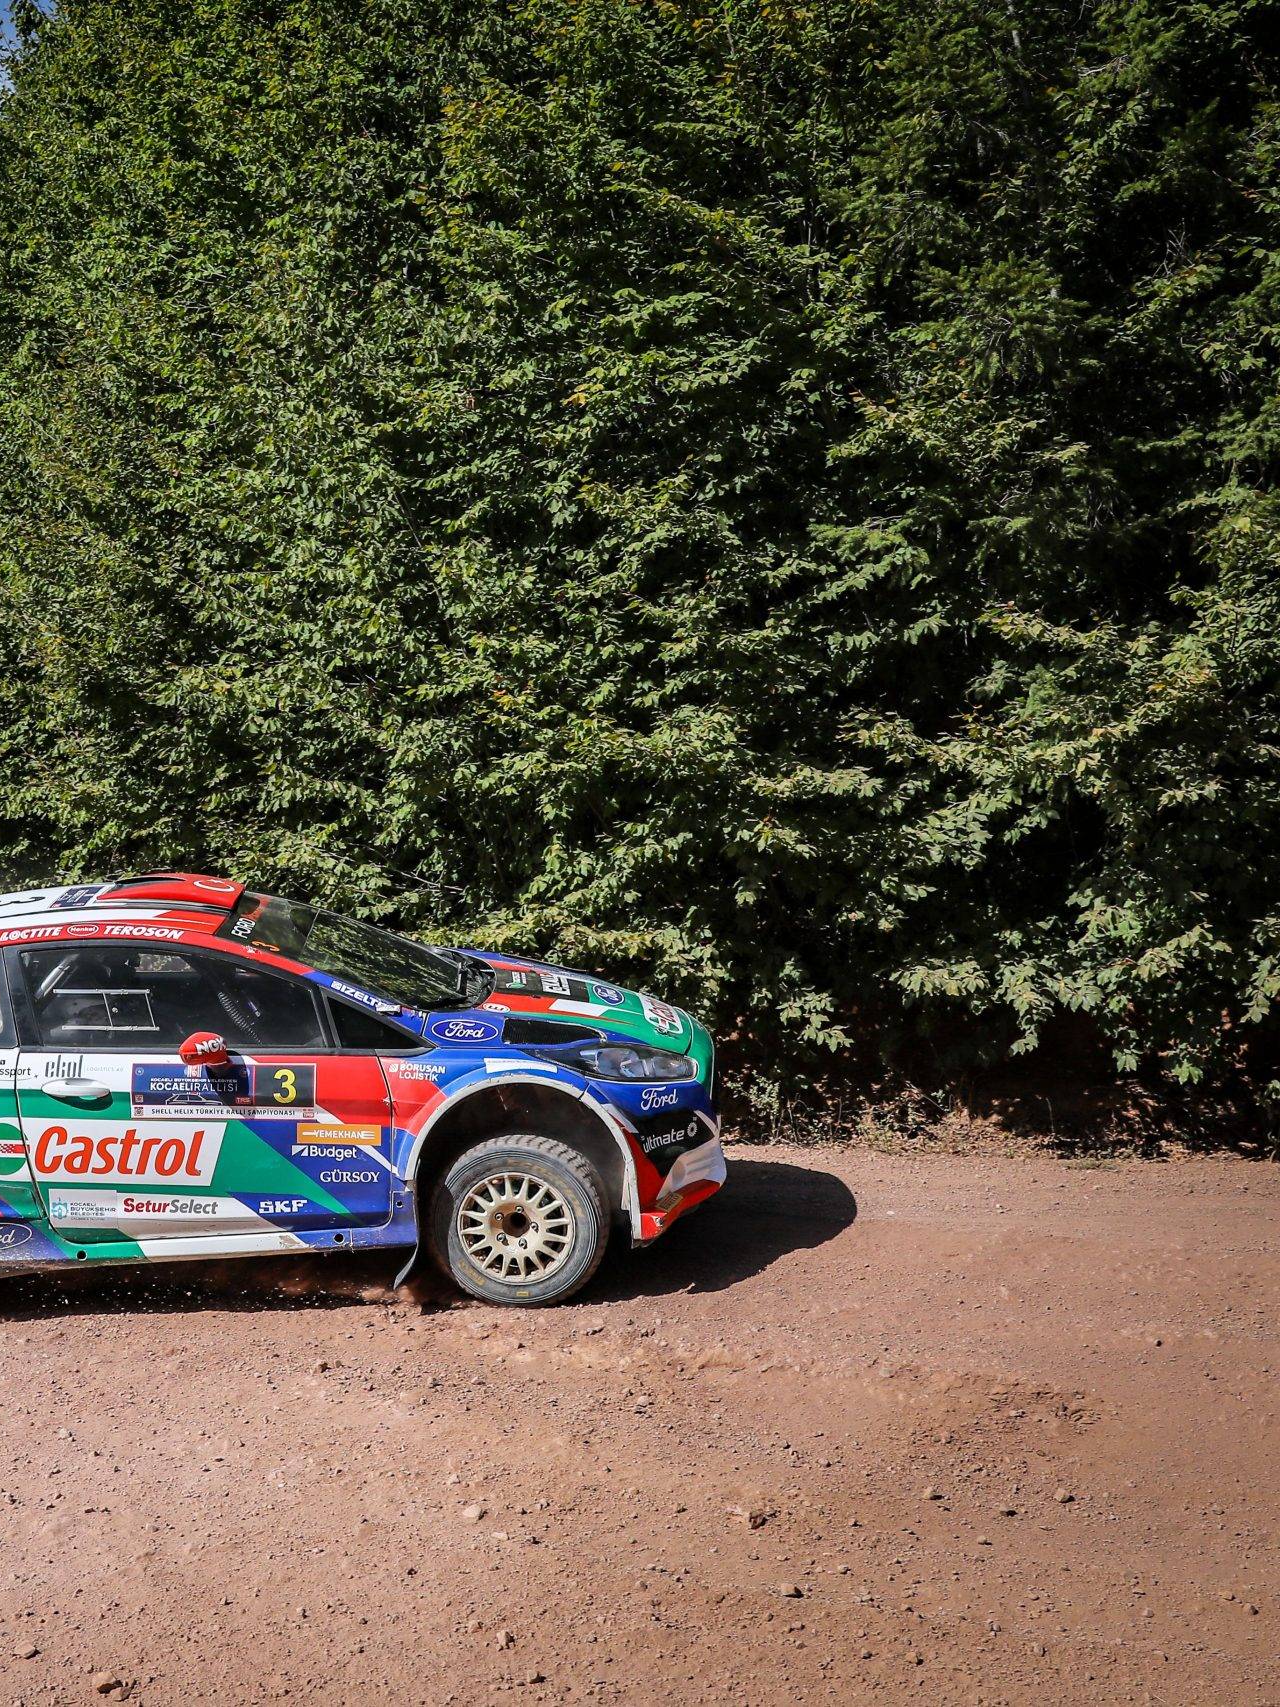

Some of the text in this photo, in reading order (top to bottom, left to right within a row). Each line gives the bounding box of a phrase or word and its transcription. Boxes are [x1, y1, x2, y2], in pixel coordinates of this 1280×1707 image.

[103, 925, 185, 940] TEROSON
[231, 917, 257, 939] FORD
[251, 940, 280, 952] 3
[444, 1021, 484, 1038] Ford
[194, 1037, 227, 1056] NGK
[44, 1055, 83, 1078] ekol
[399, 1063, 446, 1074] BORUSAN
[273, 1068, 298, 1104] 3
[640, 1086, 678, 1110] Ford
[195, 1107, 225, 1115] TÜRKİYE
[643, 1128, 685, 1153] ultimate
[34, 1125, 205, 1176] Castrol
[310, 1145, 357, 1161] Budget
[320, 1169, 380, 1183] GÜRSOY
[259, 1199, 308, 1214] SKF
